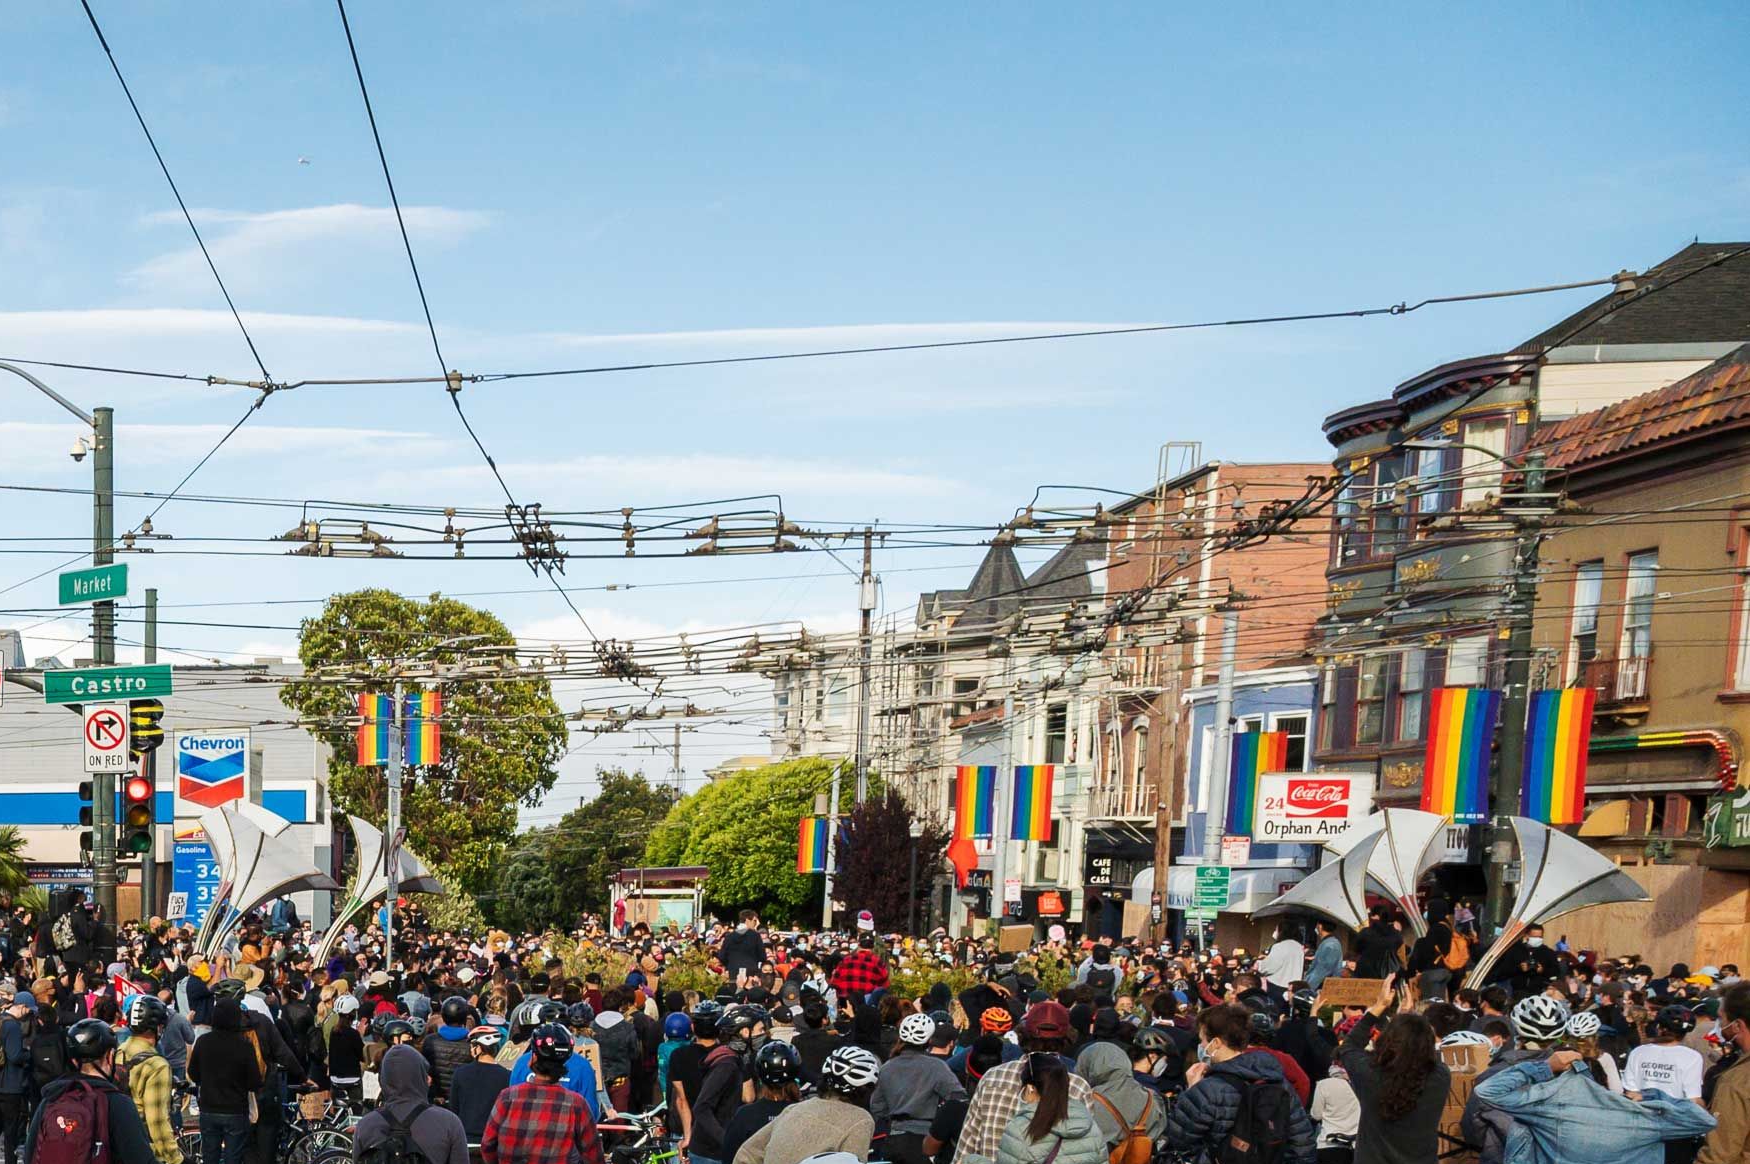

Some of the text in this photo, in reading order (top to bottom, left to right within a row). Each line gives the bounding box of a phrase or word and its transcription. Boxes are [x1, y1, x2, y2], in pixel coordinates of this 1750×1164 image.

[73, 574, 112, 596] Market
[71, 676, 147, 695] Castro
[179, 736, 245, 751] Chevron
[89, 754, 123, 767] ON RED
[1264, 797, 1285, 810] 24
[1264, 820, 1313, 839] Orphan
[175, 846, 207, 854] Gasoline
[1092, 858, 1112, 867] CAFE
[1100, 867, 1111, 876] DE
[1090, 875, 1111, 884] CASA
[1641, 1062, 1675, 1072] GEORGE
